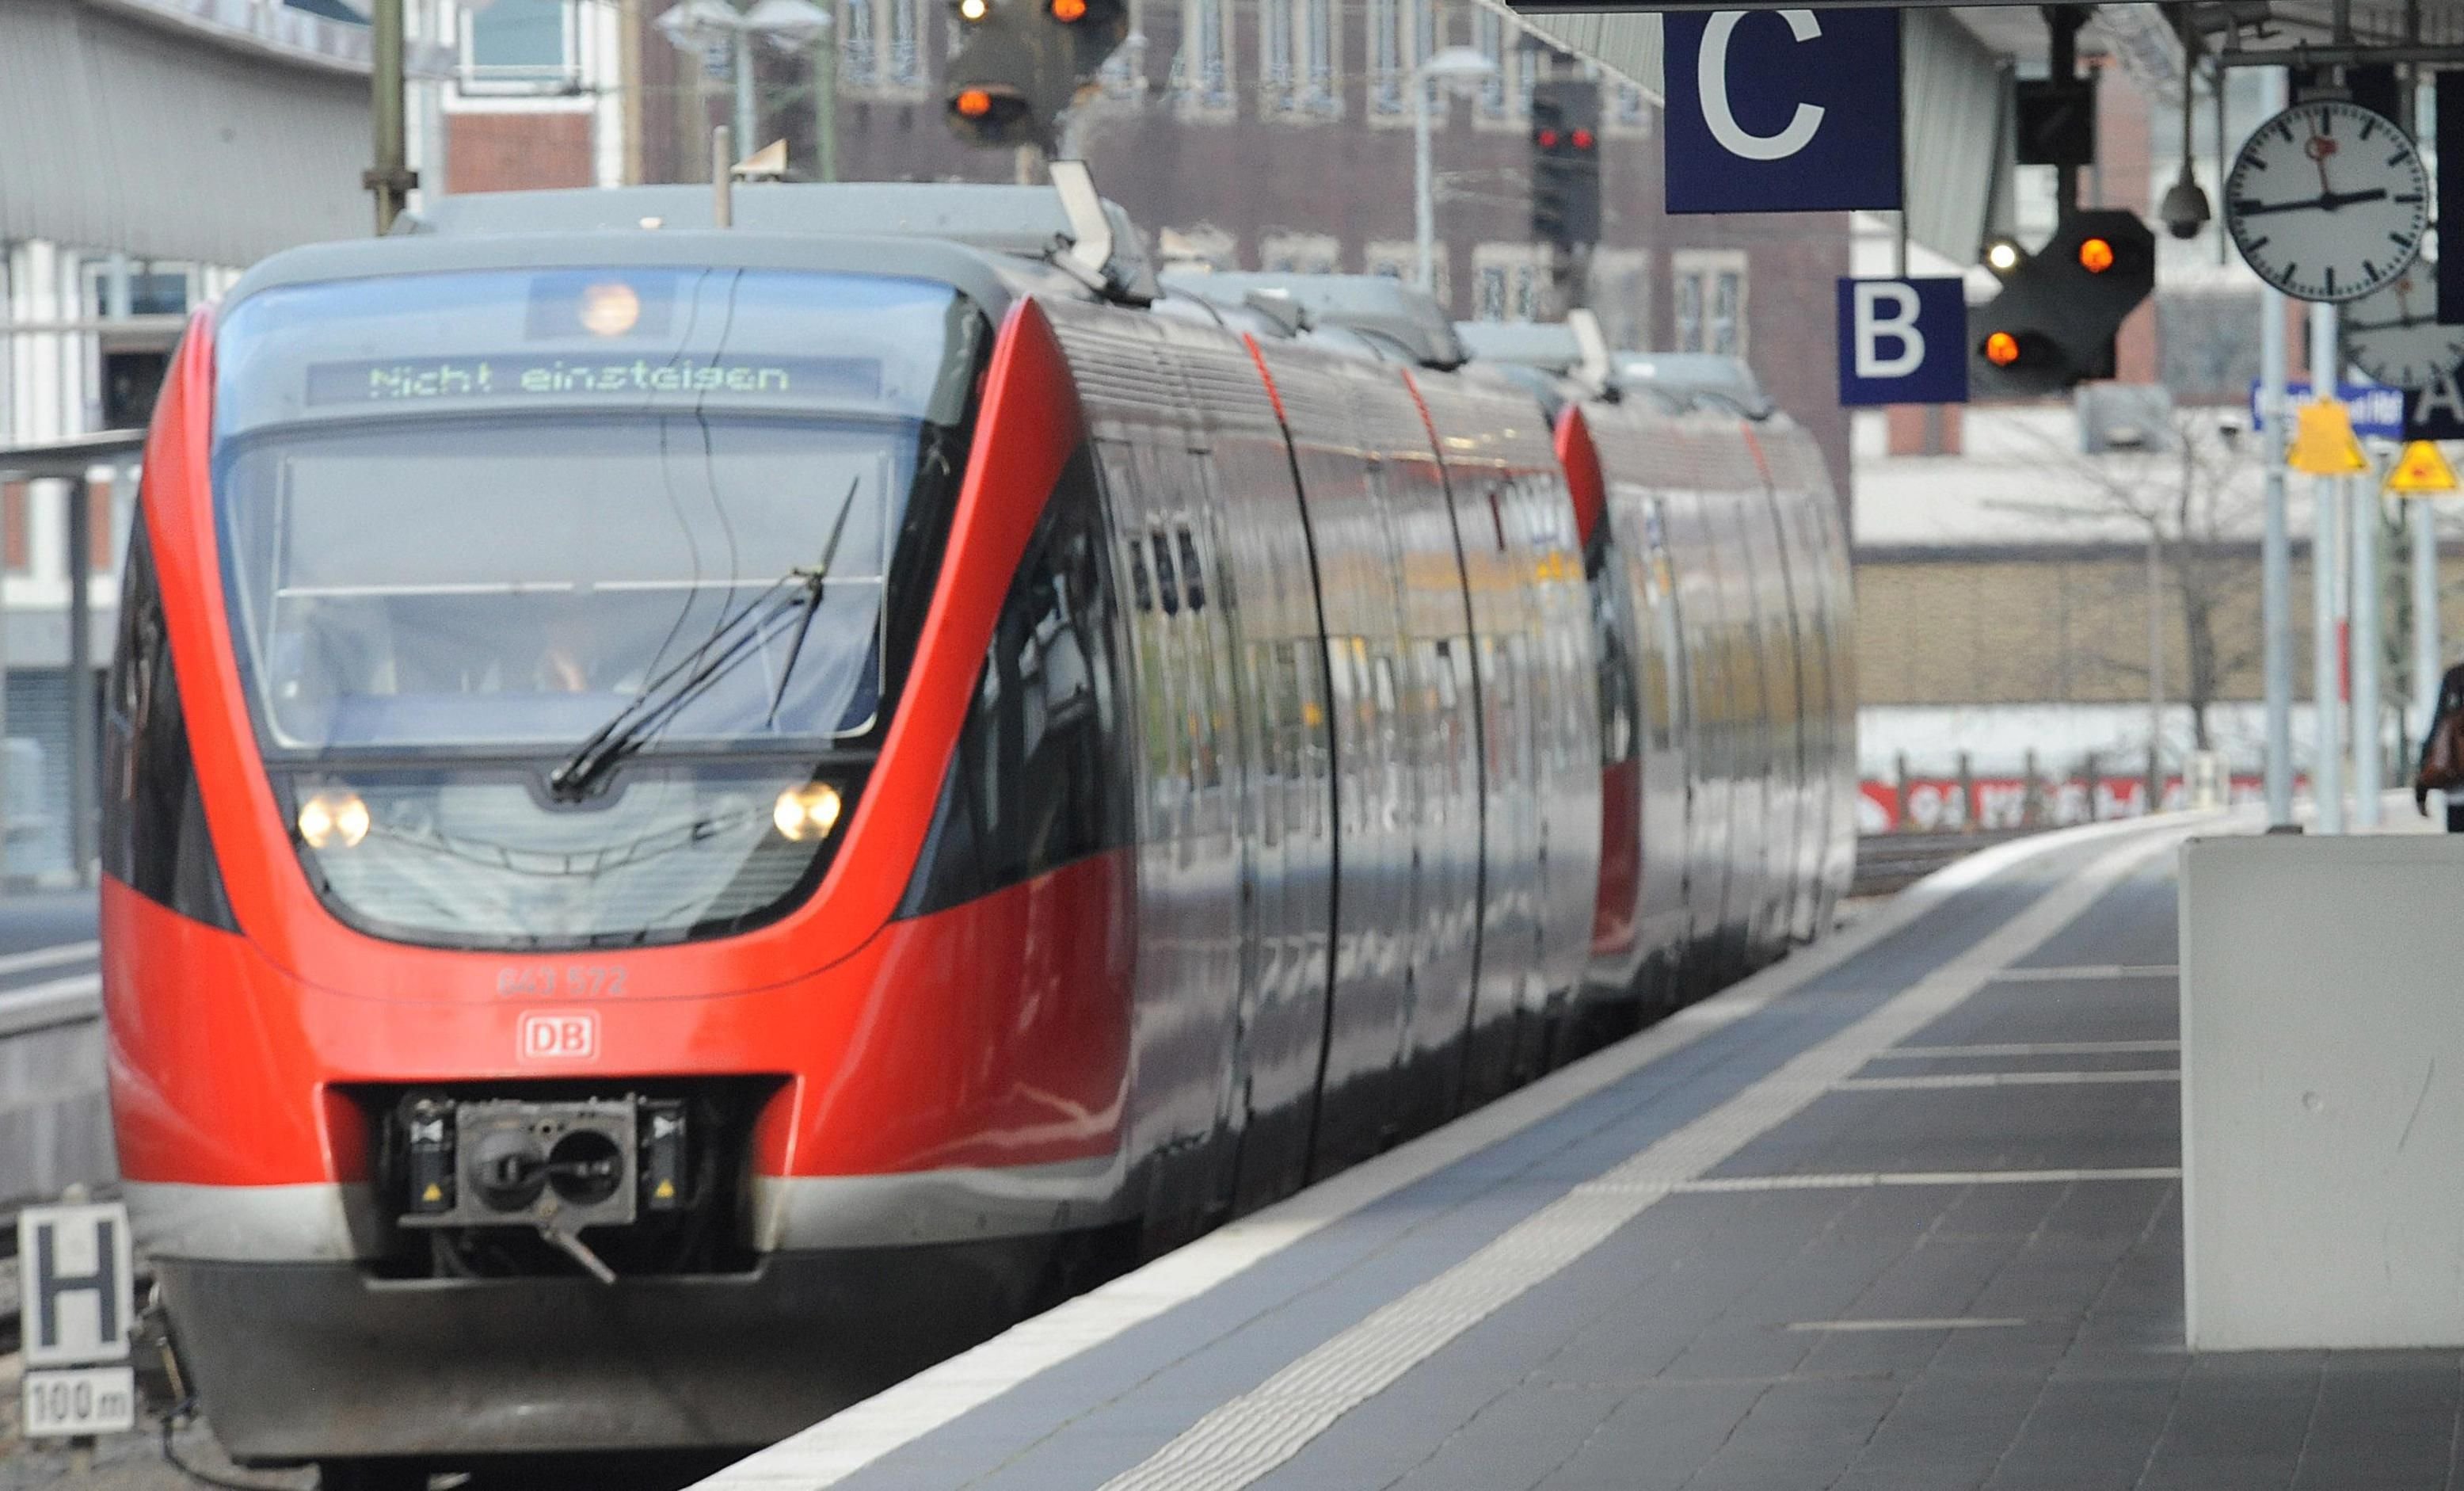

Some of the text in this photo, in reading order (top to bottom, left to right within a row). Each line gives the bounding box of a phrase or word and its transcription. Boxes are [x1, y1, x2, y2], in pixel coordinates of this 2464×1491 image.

[1697, 10, 1826, 160] C
[1853, 282, 1925, 379] B
[520, 357, 790, 393] einsteigen
[2414, 364, 2464, 424] A
[566, 965, 628, 996] 572
[531, 1021, 586, 1051] DB
[37, 1221, 117, 1347] H
[30, 1380, 128, 1422] 100 m
